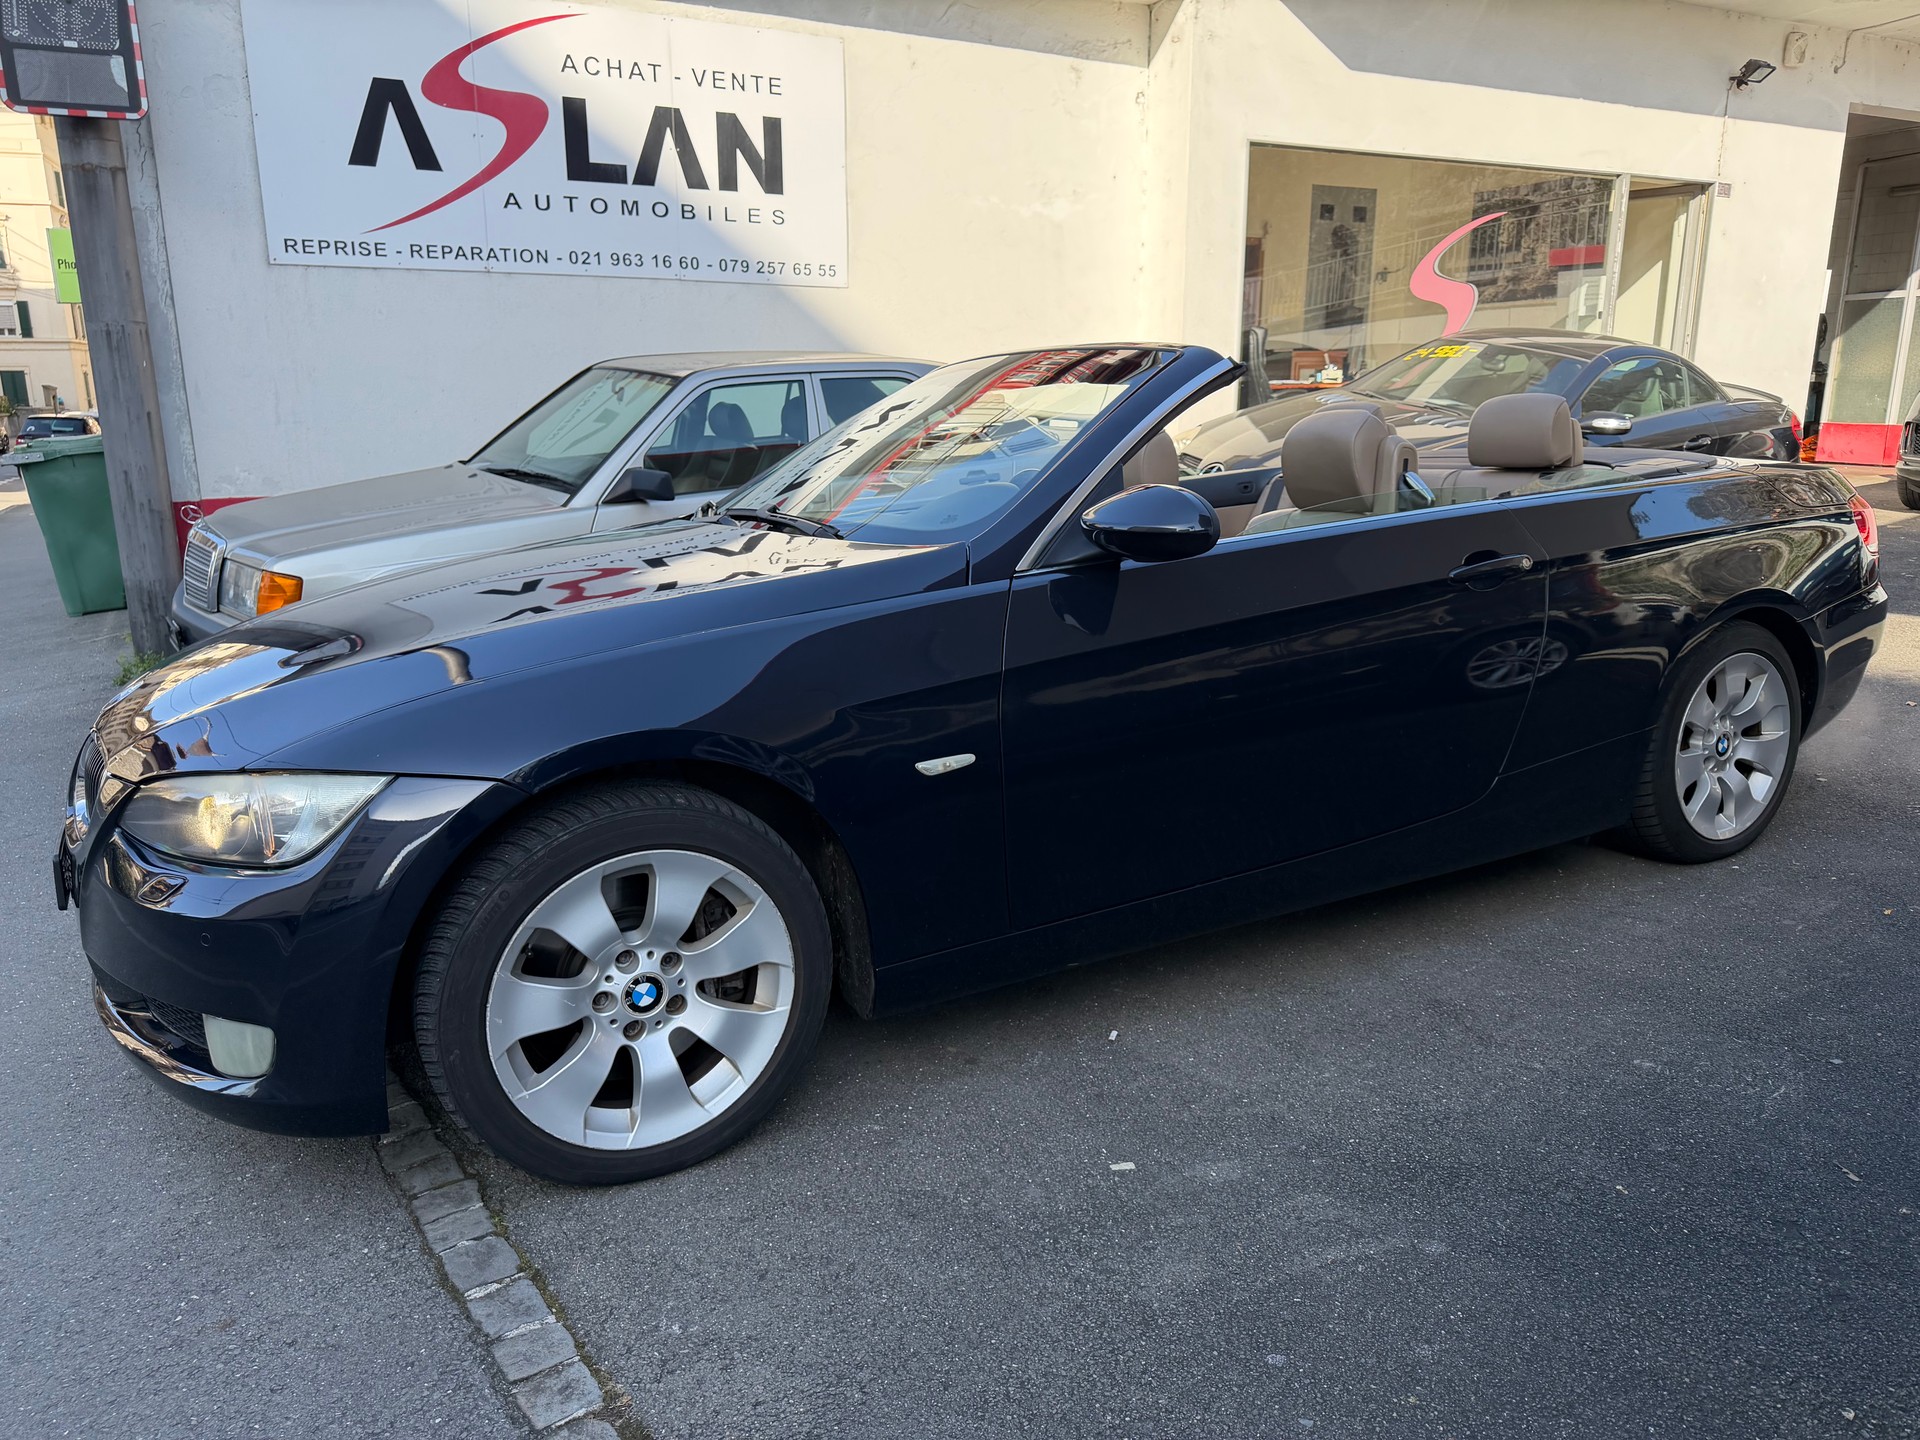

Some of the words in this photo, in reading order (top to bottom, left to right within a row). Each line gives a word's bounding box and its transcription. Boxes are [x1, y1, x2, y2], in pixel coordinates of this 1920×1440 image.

[561, 53, 662, 84] ACHAT
[692, 67, 783, 96] VENTE
[348, 14, 785, 233] ASLAN
[503, 191, 786, 226] AUTOMOBILES
[284, 237, 388, 258] REPRISE
[410, 243, 549, 265] REPARATION
[568, 250, 602, 267] 021
[610, 252, 645, 269] 963
[651, 254, 673, 270] 16
[679, 255, 700, 271] 60
[719, 258, 750, 274] 079
[756, 260, 786, 276] 257
[793, 262, 812, 278] 65
[819, 264, 837, 279] 55
